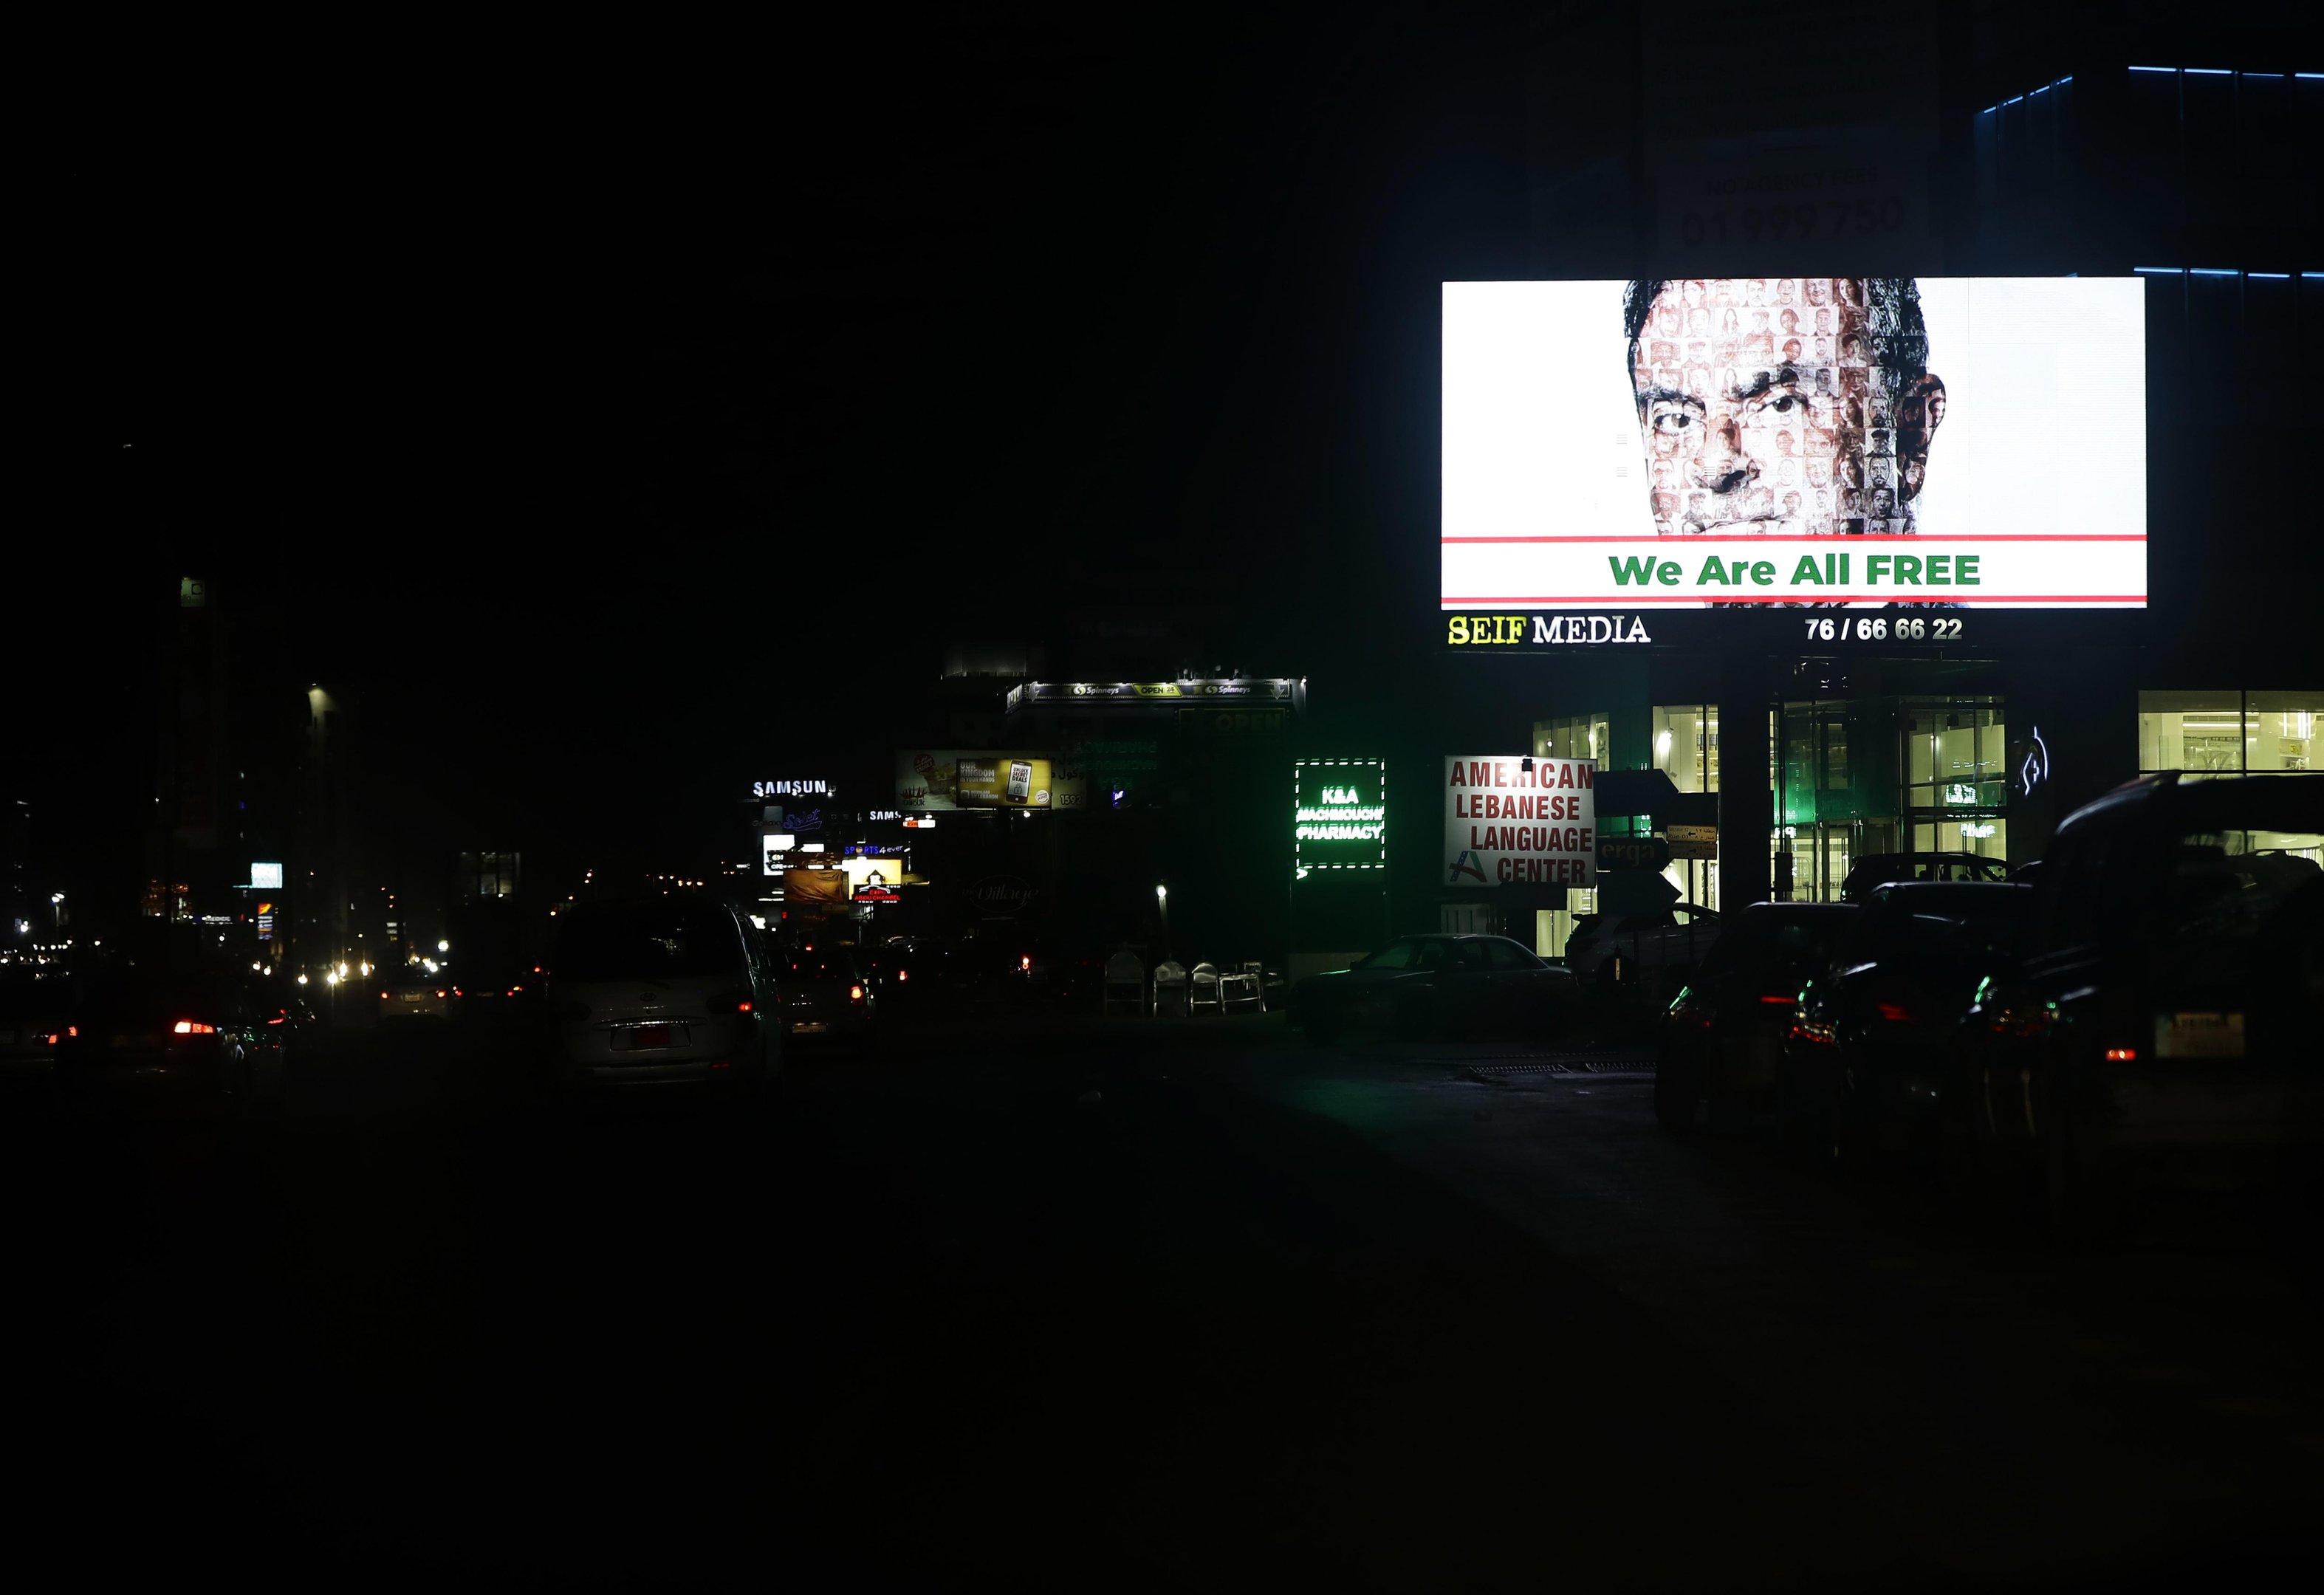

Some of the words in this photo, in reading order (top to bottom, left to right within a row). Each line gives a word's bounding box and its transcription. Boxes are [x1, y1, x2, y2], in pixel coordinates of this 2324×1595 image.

[1681, 211, 1727, 247] 01
[1741, 202, 1817, 244] 999
[1825, 196, 1904, 236] 750
[1608, 555, 1682, 586] We
[1697, 555, 1775, 586] Are
[1791, 553, 1849, 585] All
[1867, 555, 1981, 586] FREE
[1447, 616, 1527, 645] SEIF
[1532, 615, 1652, 645] MEDIA
[1805, 618, 1835, 641] 76
[1857, 618, 1888, 641] 66
[1895, 618, 1925, 641] 66
[1932, 618, 1963, 641] 22
[1086, 685, 1120, 696] Spinneys
[1218, 685, 1251, 695] Spinneys
[960, 761, 976, 769] OUR
[960, 769, 995, 777] KINGDOM
[1450, 761, 1593, 789] AMERICAN
[1060, 794, 1082, 806] 1592
[1322, 787, 1360, 804] K&A
[1456, 794, 1580, 820] LEBANESE
[1298, 826, 1382, 840] PHARMACY
[1470, 826, 1592, 852] LANGUAGE
[1497, 857, 1586, 884] CENTER
